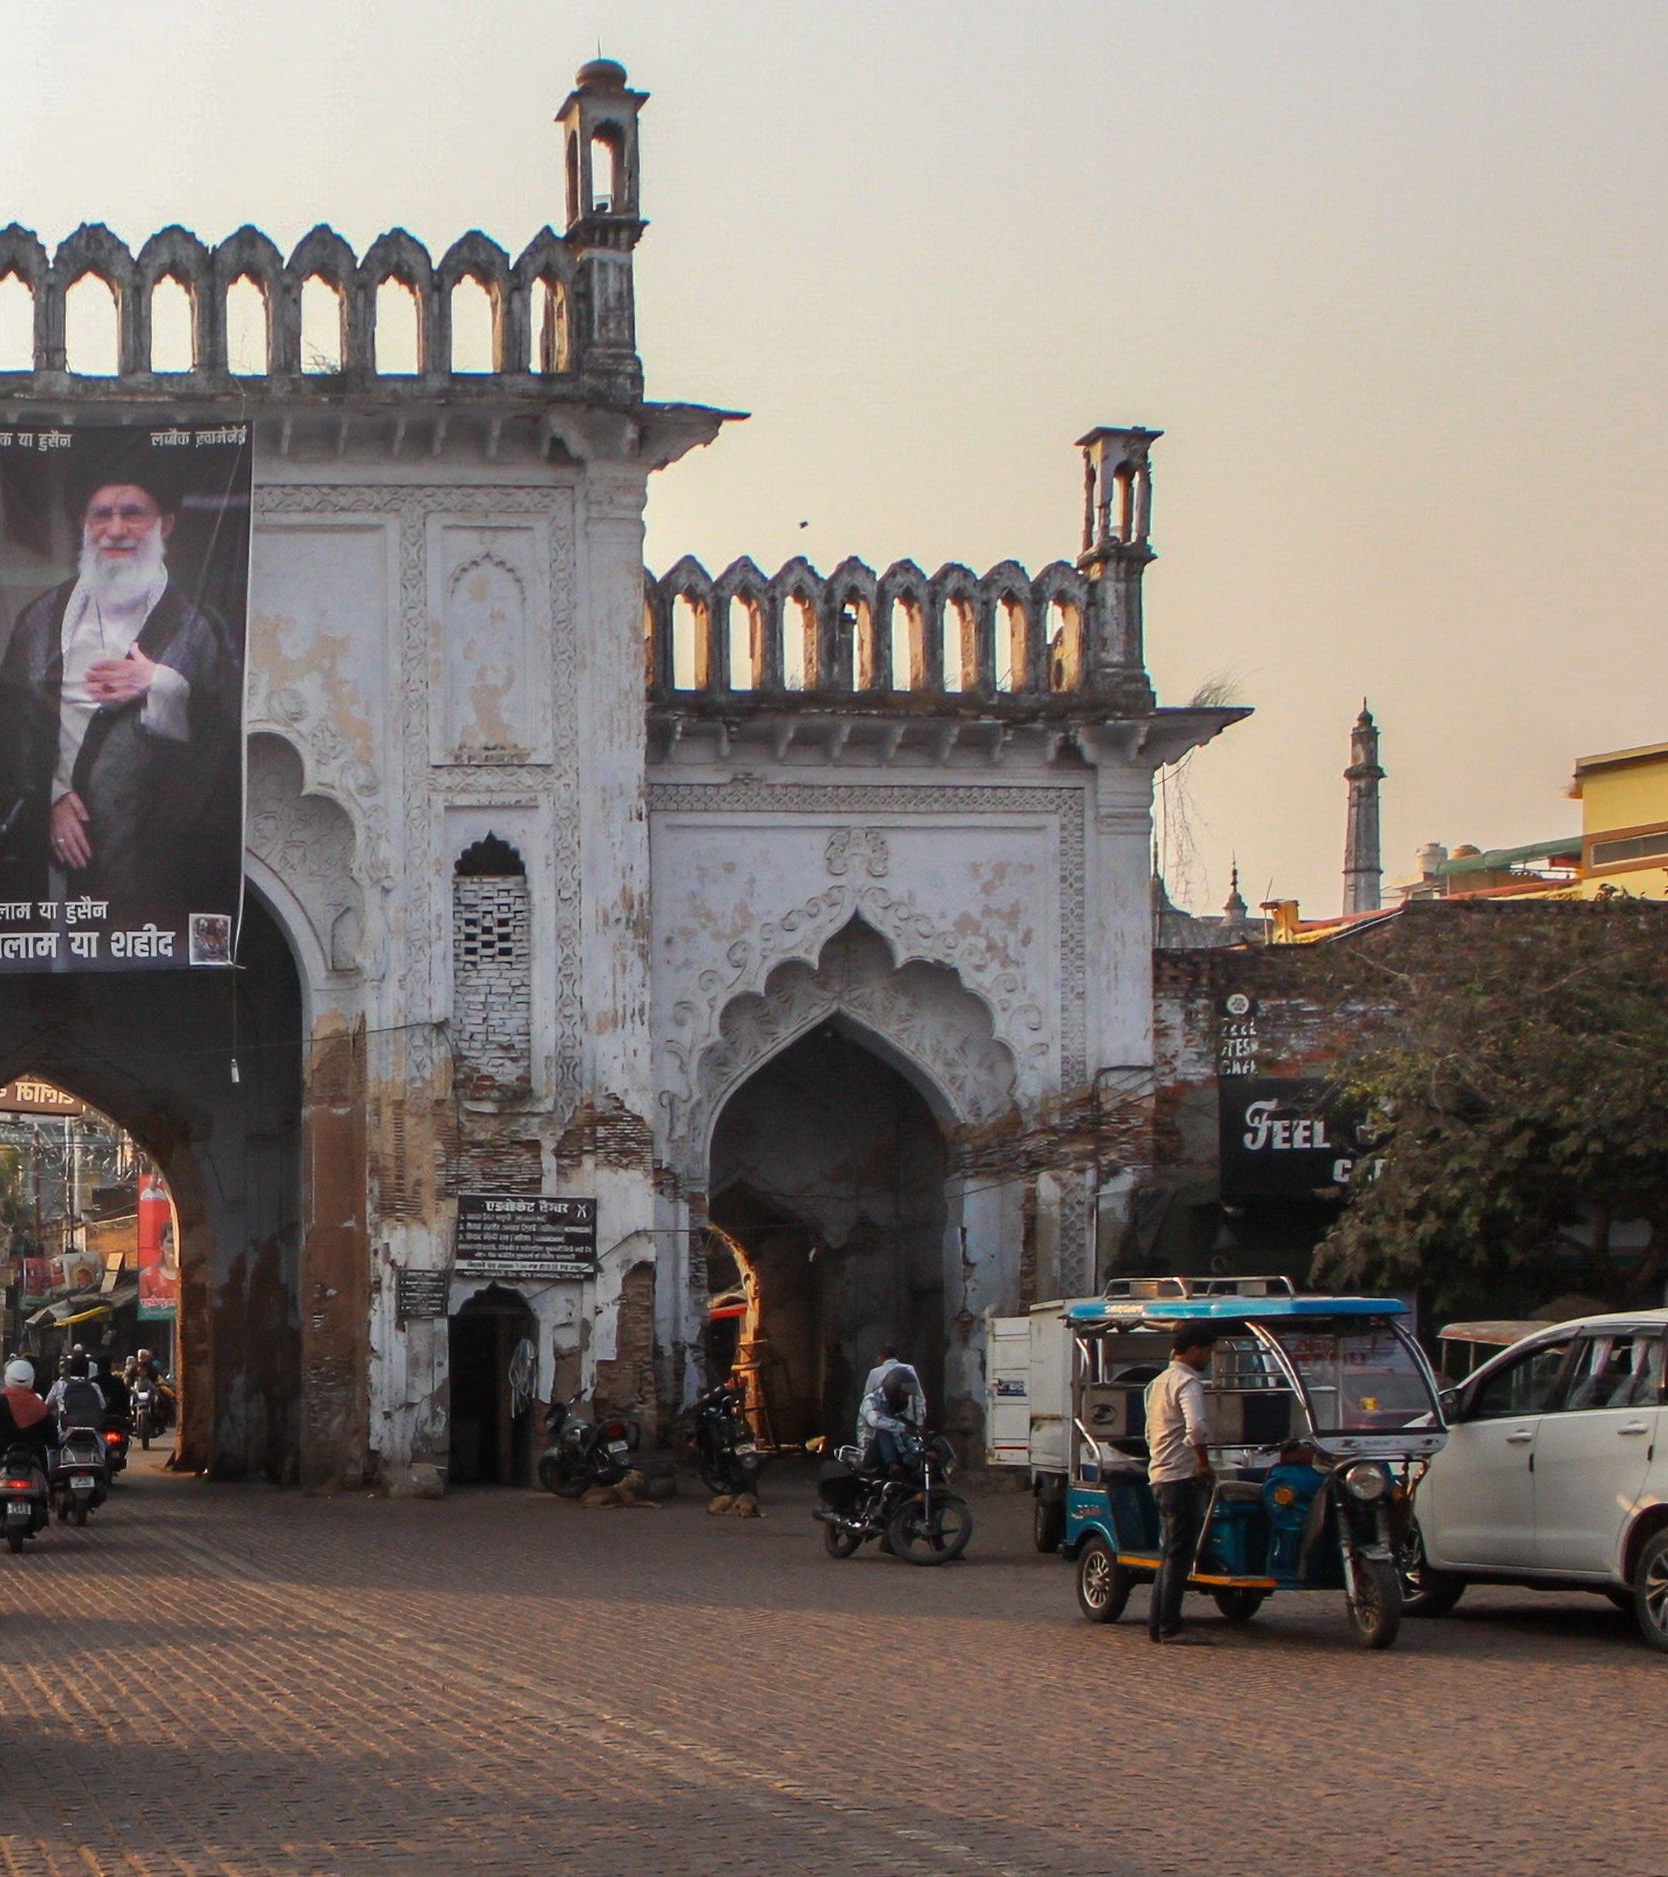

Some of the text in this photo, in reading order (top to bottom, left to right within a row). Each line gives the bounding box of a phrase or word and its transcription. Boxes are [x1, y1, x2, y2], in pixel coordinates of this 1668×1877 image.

[18, 431, 32, 447] या
[38, 430, 72, 451] हुसैन
[38, 902, 58, 920] या
[65, 896, 109, 924] हुसैन
[68, 931, 99, 958] या
[111, 923, 175, 957] शहीद
[1243, 1098, 1331, 1150] FEEL
